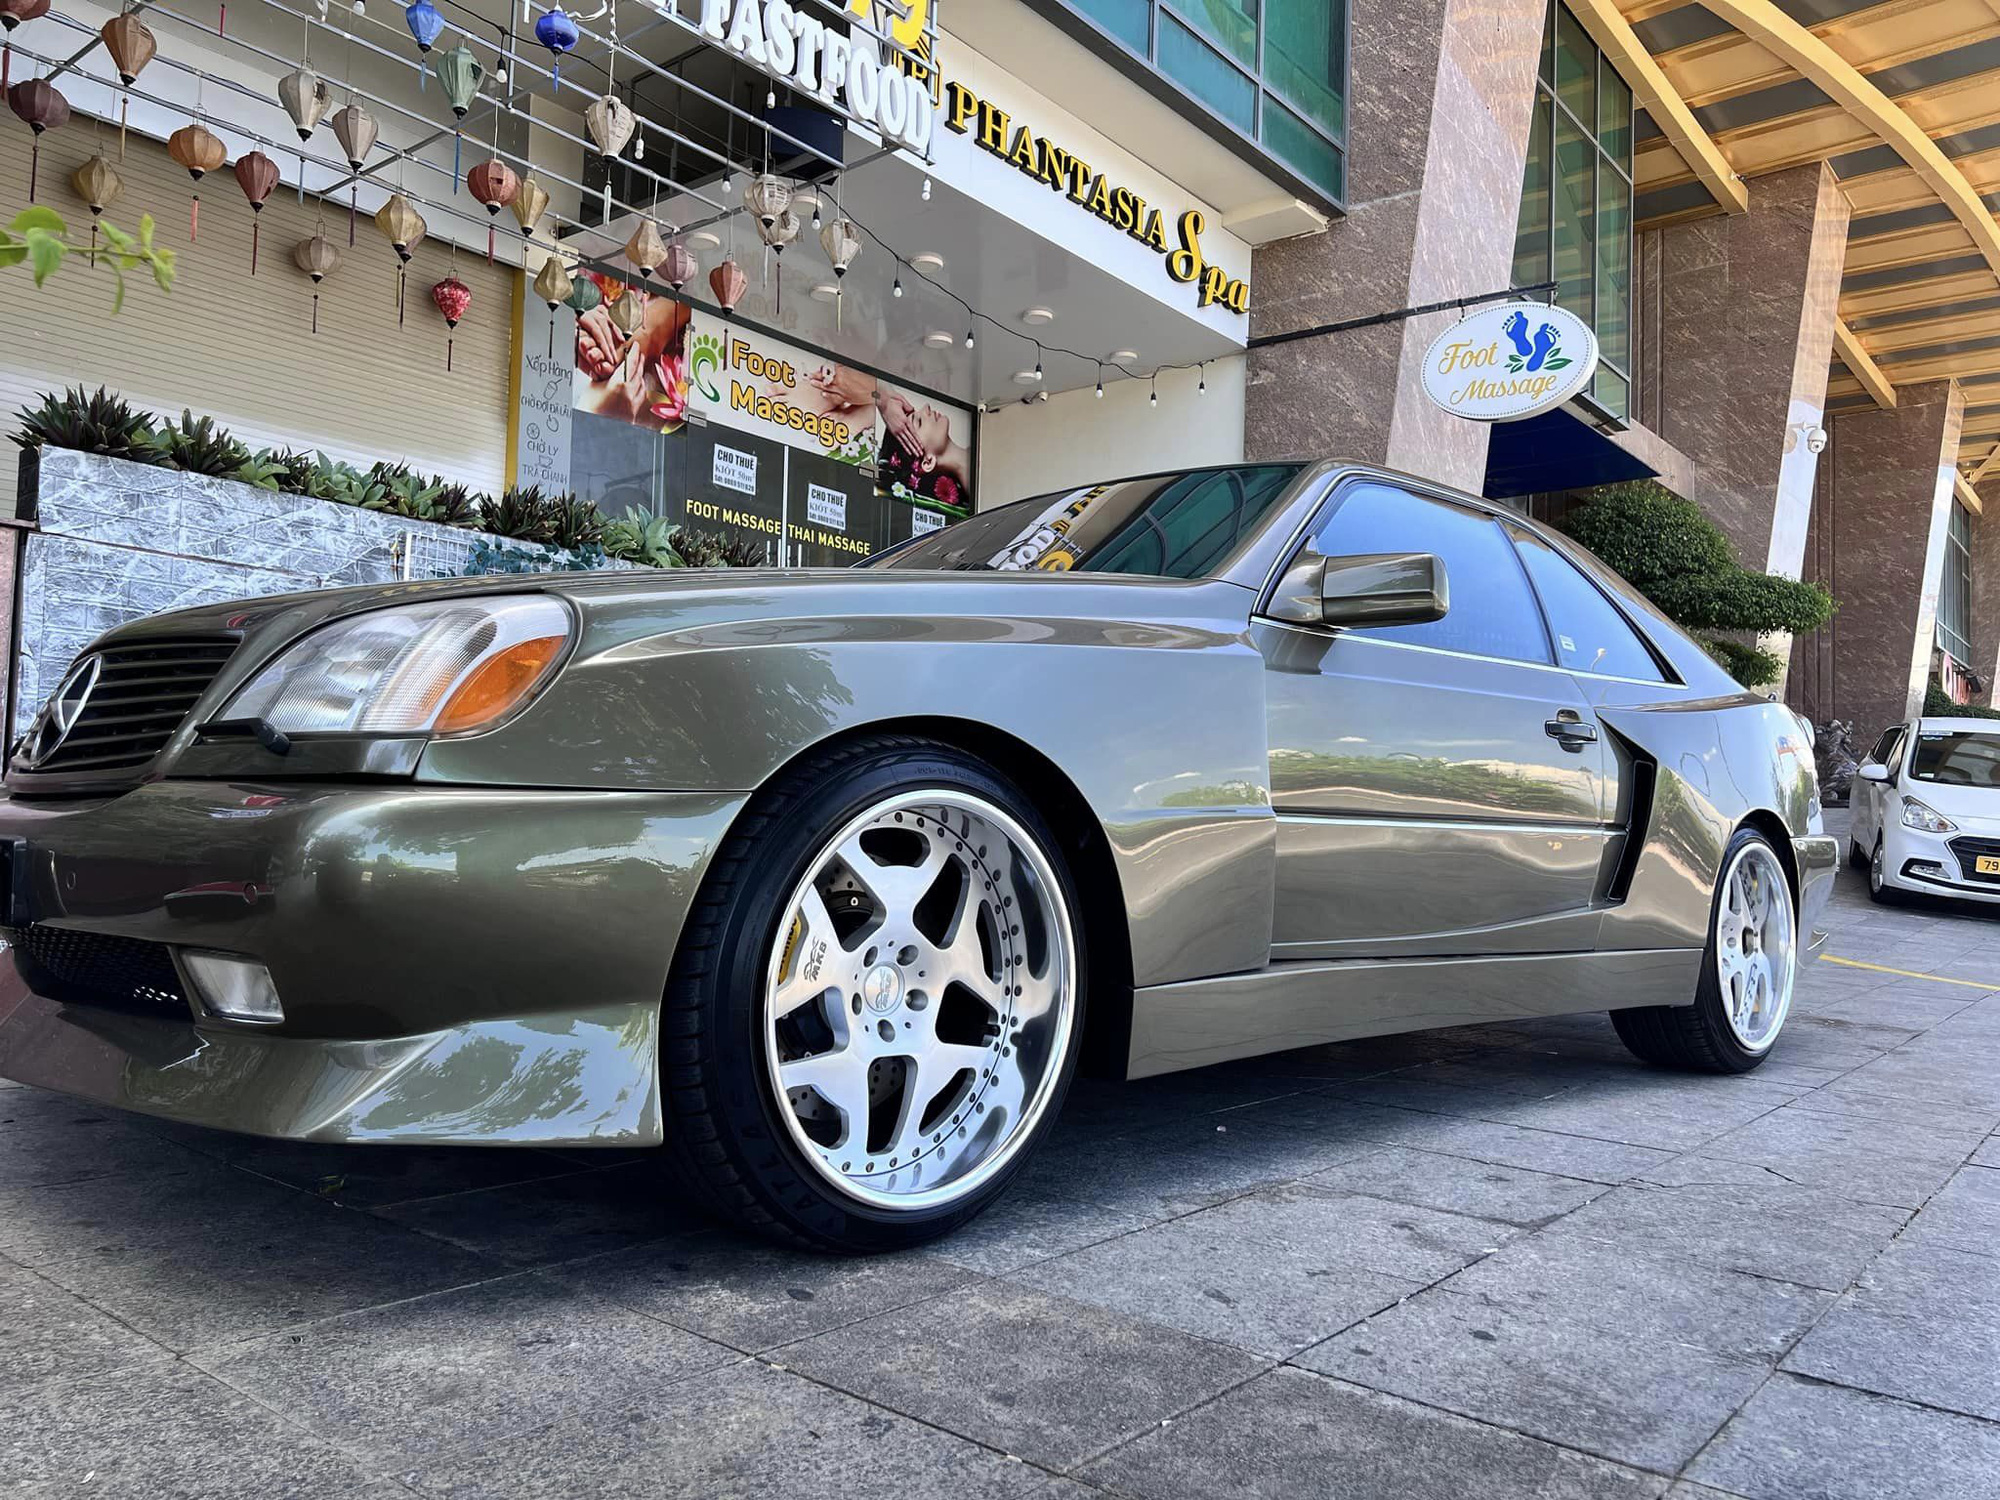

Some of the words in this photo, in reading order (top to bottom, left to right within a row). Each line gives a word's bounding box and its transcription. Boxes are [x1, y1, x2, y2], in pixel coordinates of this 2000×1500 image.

[945, 81, 1167, 253] PHANTASIA
[1166, 211, 1249, 314] Spa
[732, 338, 796, 388] Foot
[1438, 338, 1500, 375] Foot
[1450, 375, 1558, 405] Massage
[730, 380, 850, 447] Massage
[717, 449, 734, 464] CHO
[811, 489, 826, 502] CHO
[687, 499, 720, 520] FOOT
[722, 508, 782, 535] MASSAGE
[915, 511, 928, 523] CHO
[788, 523, 815, 543] THAI
[818, 531, 871, 556] MASSAGE
[1984, 860, 1999, 871] 79
